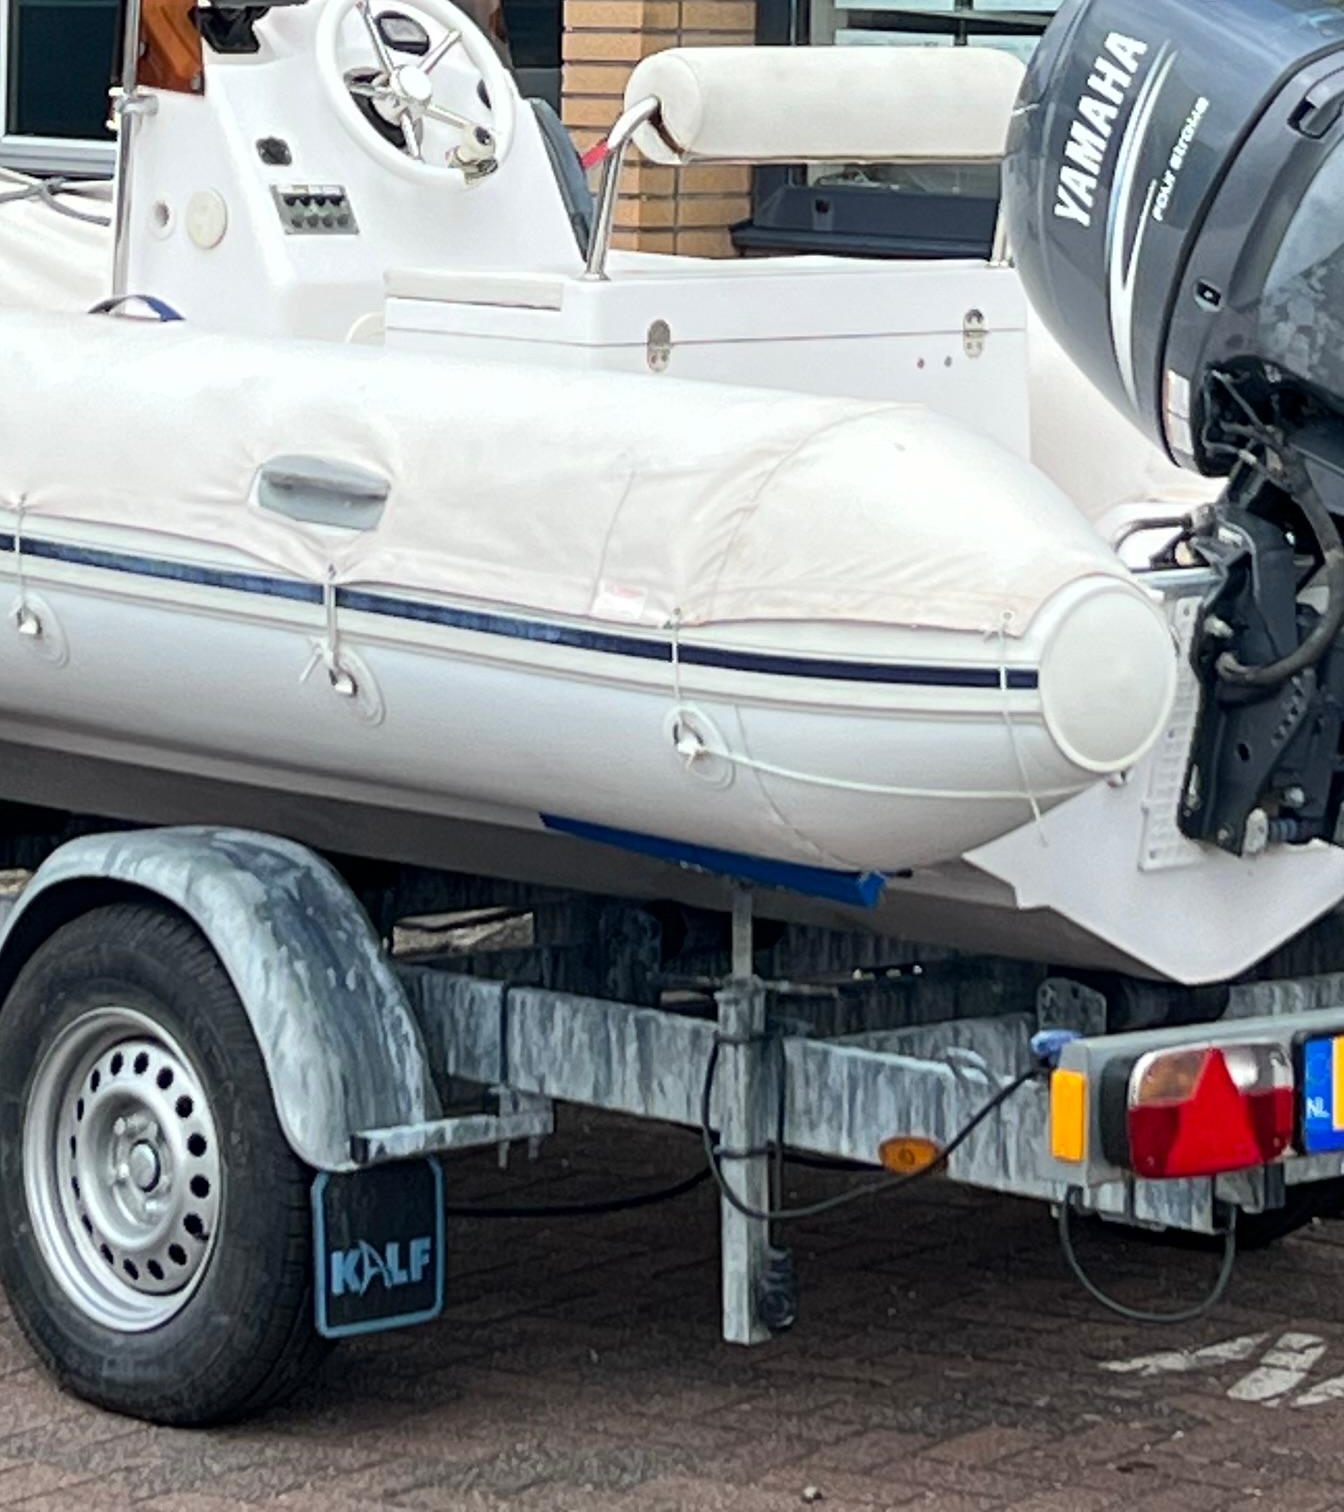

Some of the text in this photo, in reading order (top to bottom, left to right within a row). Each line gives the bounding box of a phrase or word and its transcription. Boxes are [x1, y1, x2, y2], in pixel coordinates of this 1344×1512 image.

[1054, 31, 1148, 227] YAMAHA
[1306, 1097, 1328, 1119] NL
[330, 1236, 432, 1296] KALF
